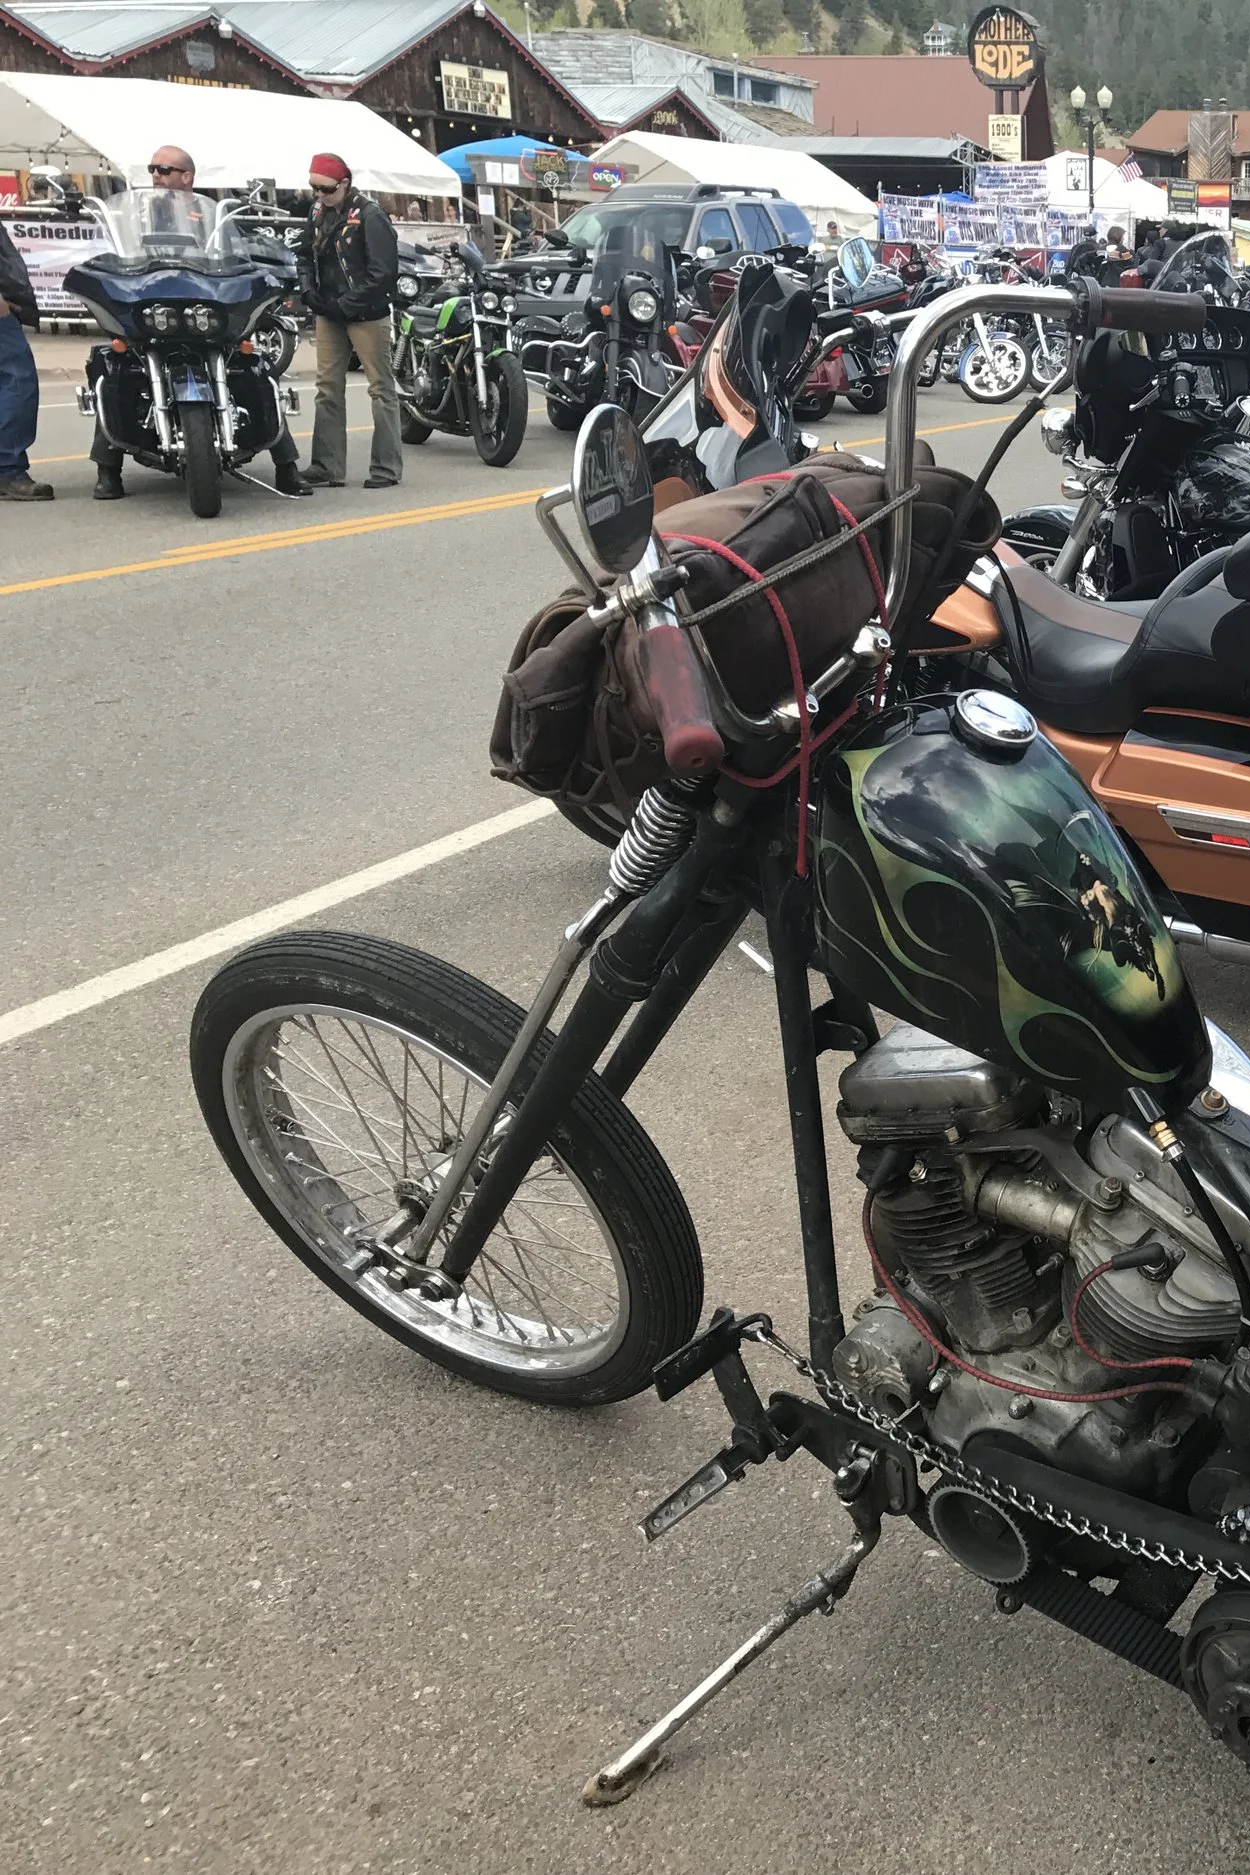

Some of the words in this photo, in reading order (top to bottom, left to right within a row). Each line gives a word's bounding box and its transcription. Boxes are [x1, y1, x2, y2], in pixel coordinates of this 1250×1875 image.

[978, 14, 1031, 40] MOTHER
[974, 44, 1034, 79] LODE
[991, 122, 1019, 137] 1900's
[535, 155, 565, 167] JACK
[592, 171, 620, 183] OPEN
[883, 195, 896, 205] LIVE
[896, 196, 917, 207] MUSIC
[917, 199, 935, 209] WITH
[909, 208, 924, 218] THE
[945, 204, 957, 215] LIVE
[957, 204, 979, 217] MUSIC
